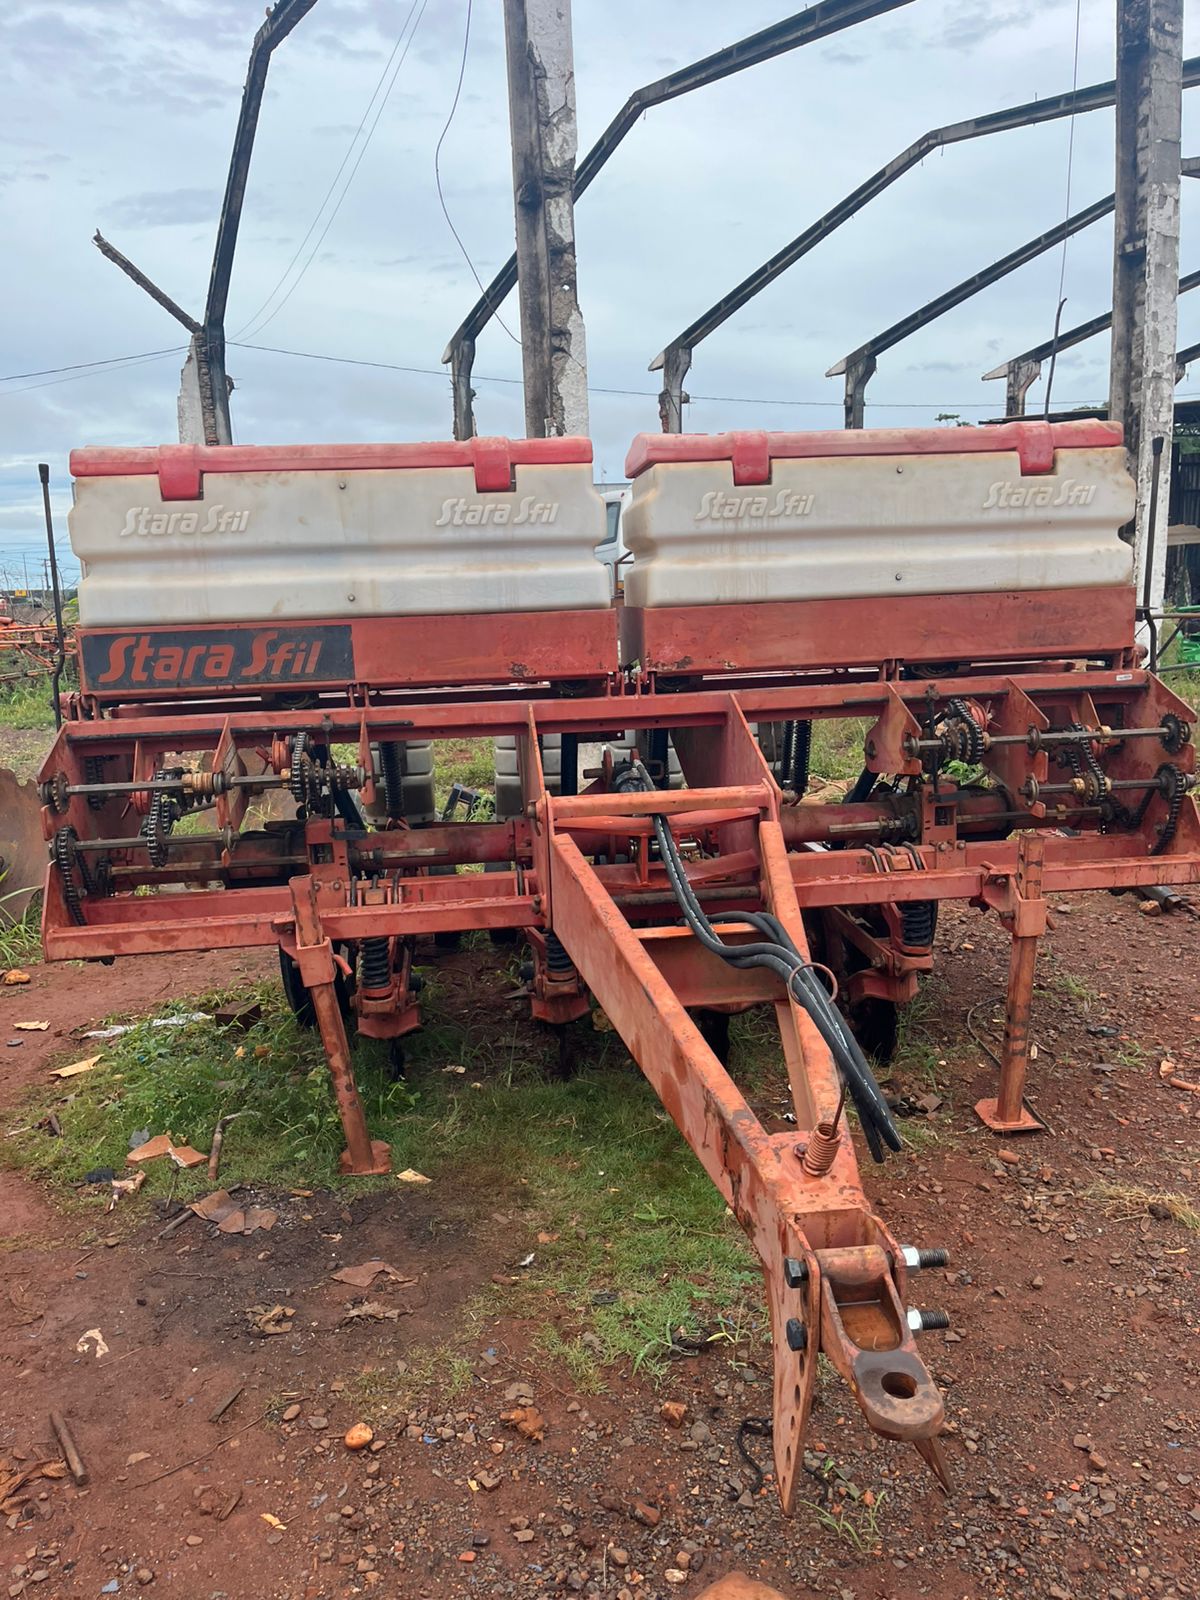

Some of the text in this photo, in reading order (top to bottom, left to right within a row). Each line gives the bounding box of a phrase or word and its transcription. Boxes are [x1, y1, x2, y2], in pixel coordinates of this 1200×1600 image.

[695, 489, 815, 520] Stara Sfil
[983, 479, 1097, 508] Stara Sfil
[120, 505, 249, 536] Stara Sfil
[435, 496, 559, 526] Stara Sfil
[98, 631, 322, 683] Stara Sfil
